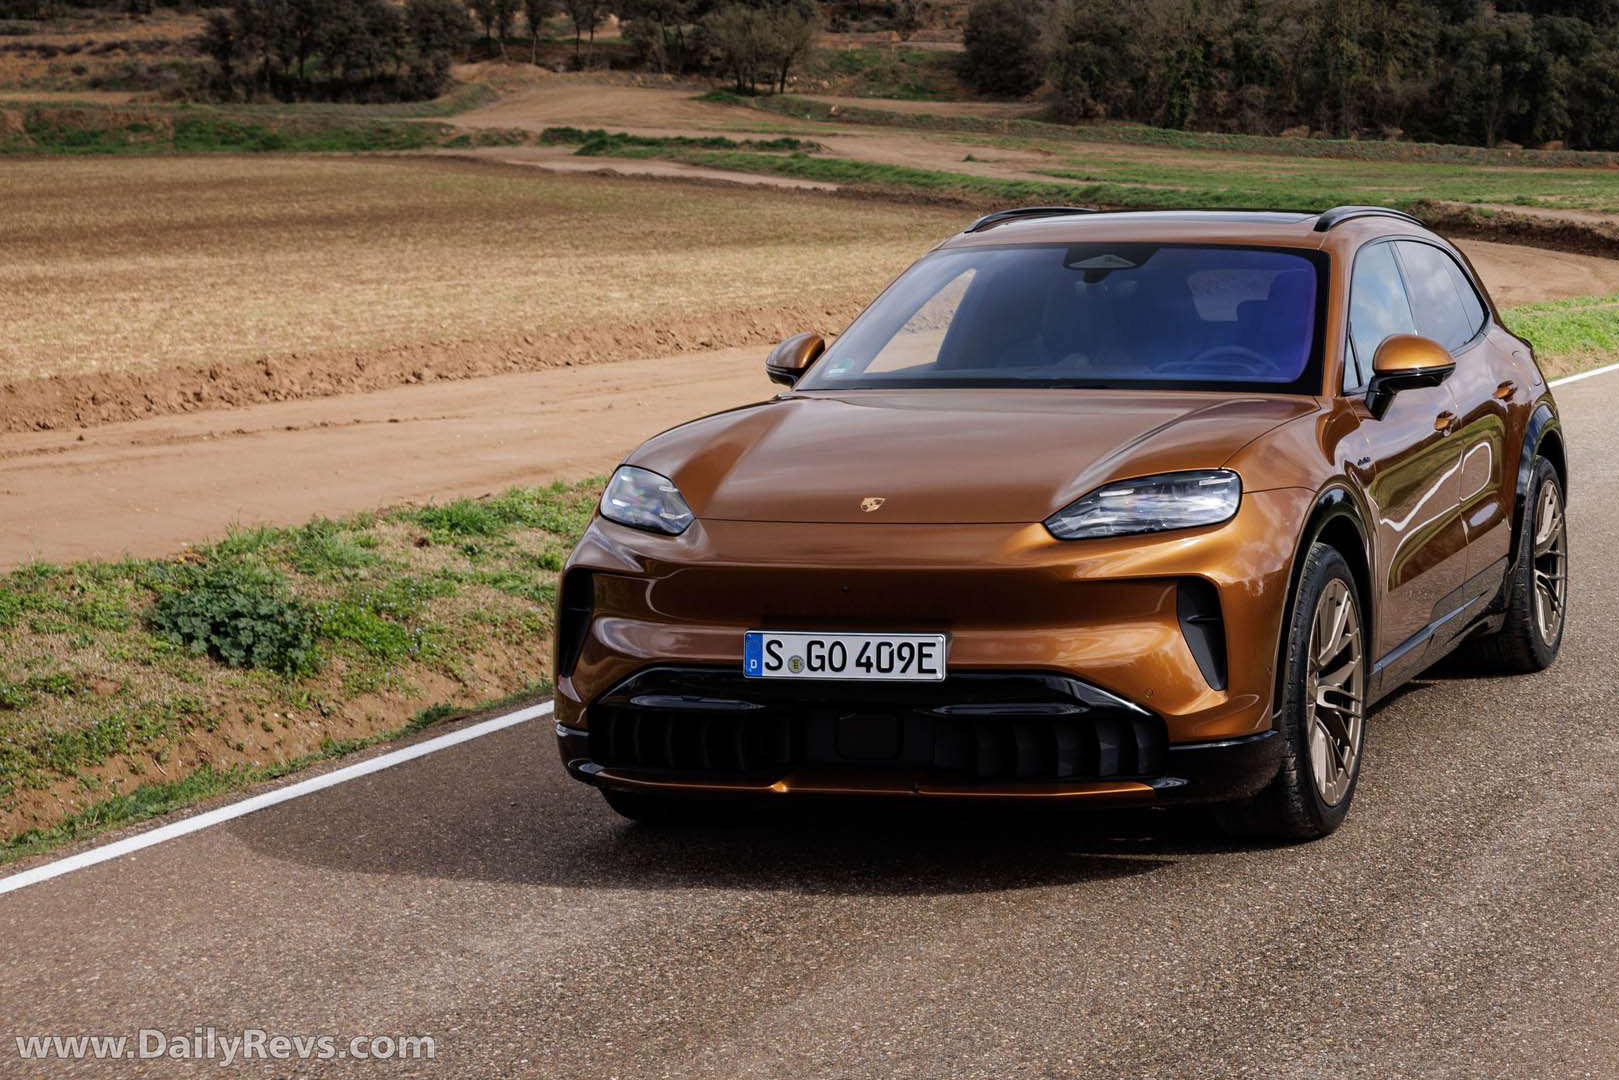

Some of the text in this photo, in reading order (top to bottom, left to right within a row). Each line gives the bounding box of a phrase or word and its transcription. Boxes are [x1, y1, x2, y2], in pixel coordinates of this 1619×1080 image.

[764, 639, 938, 674] S GO 409E
